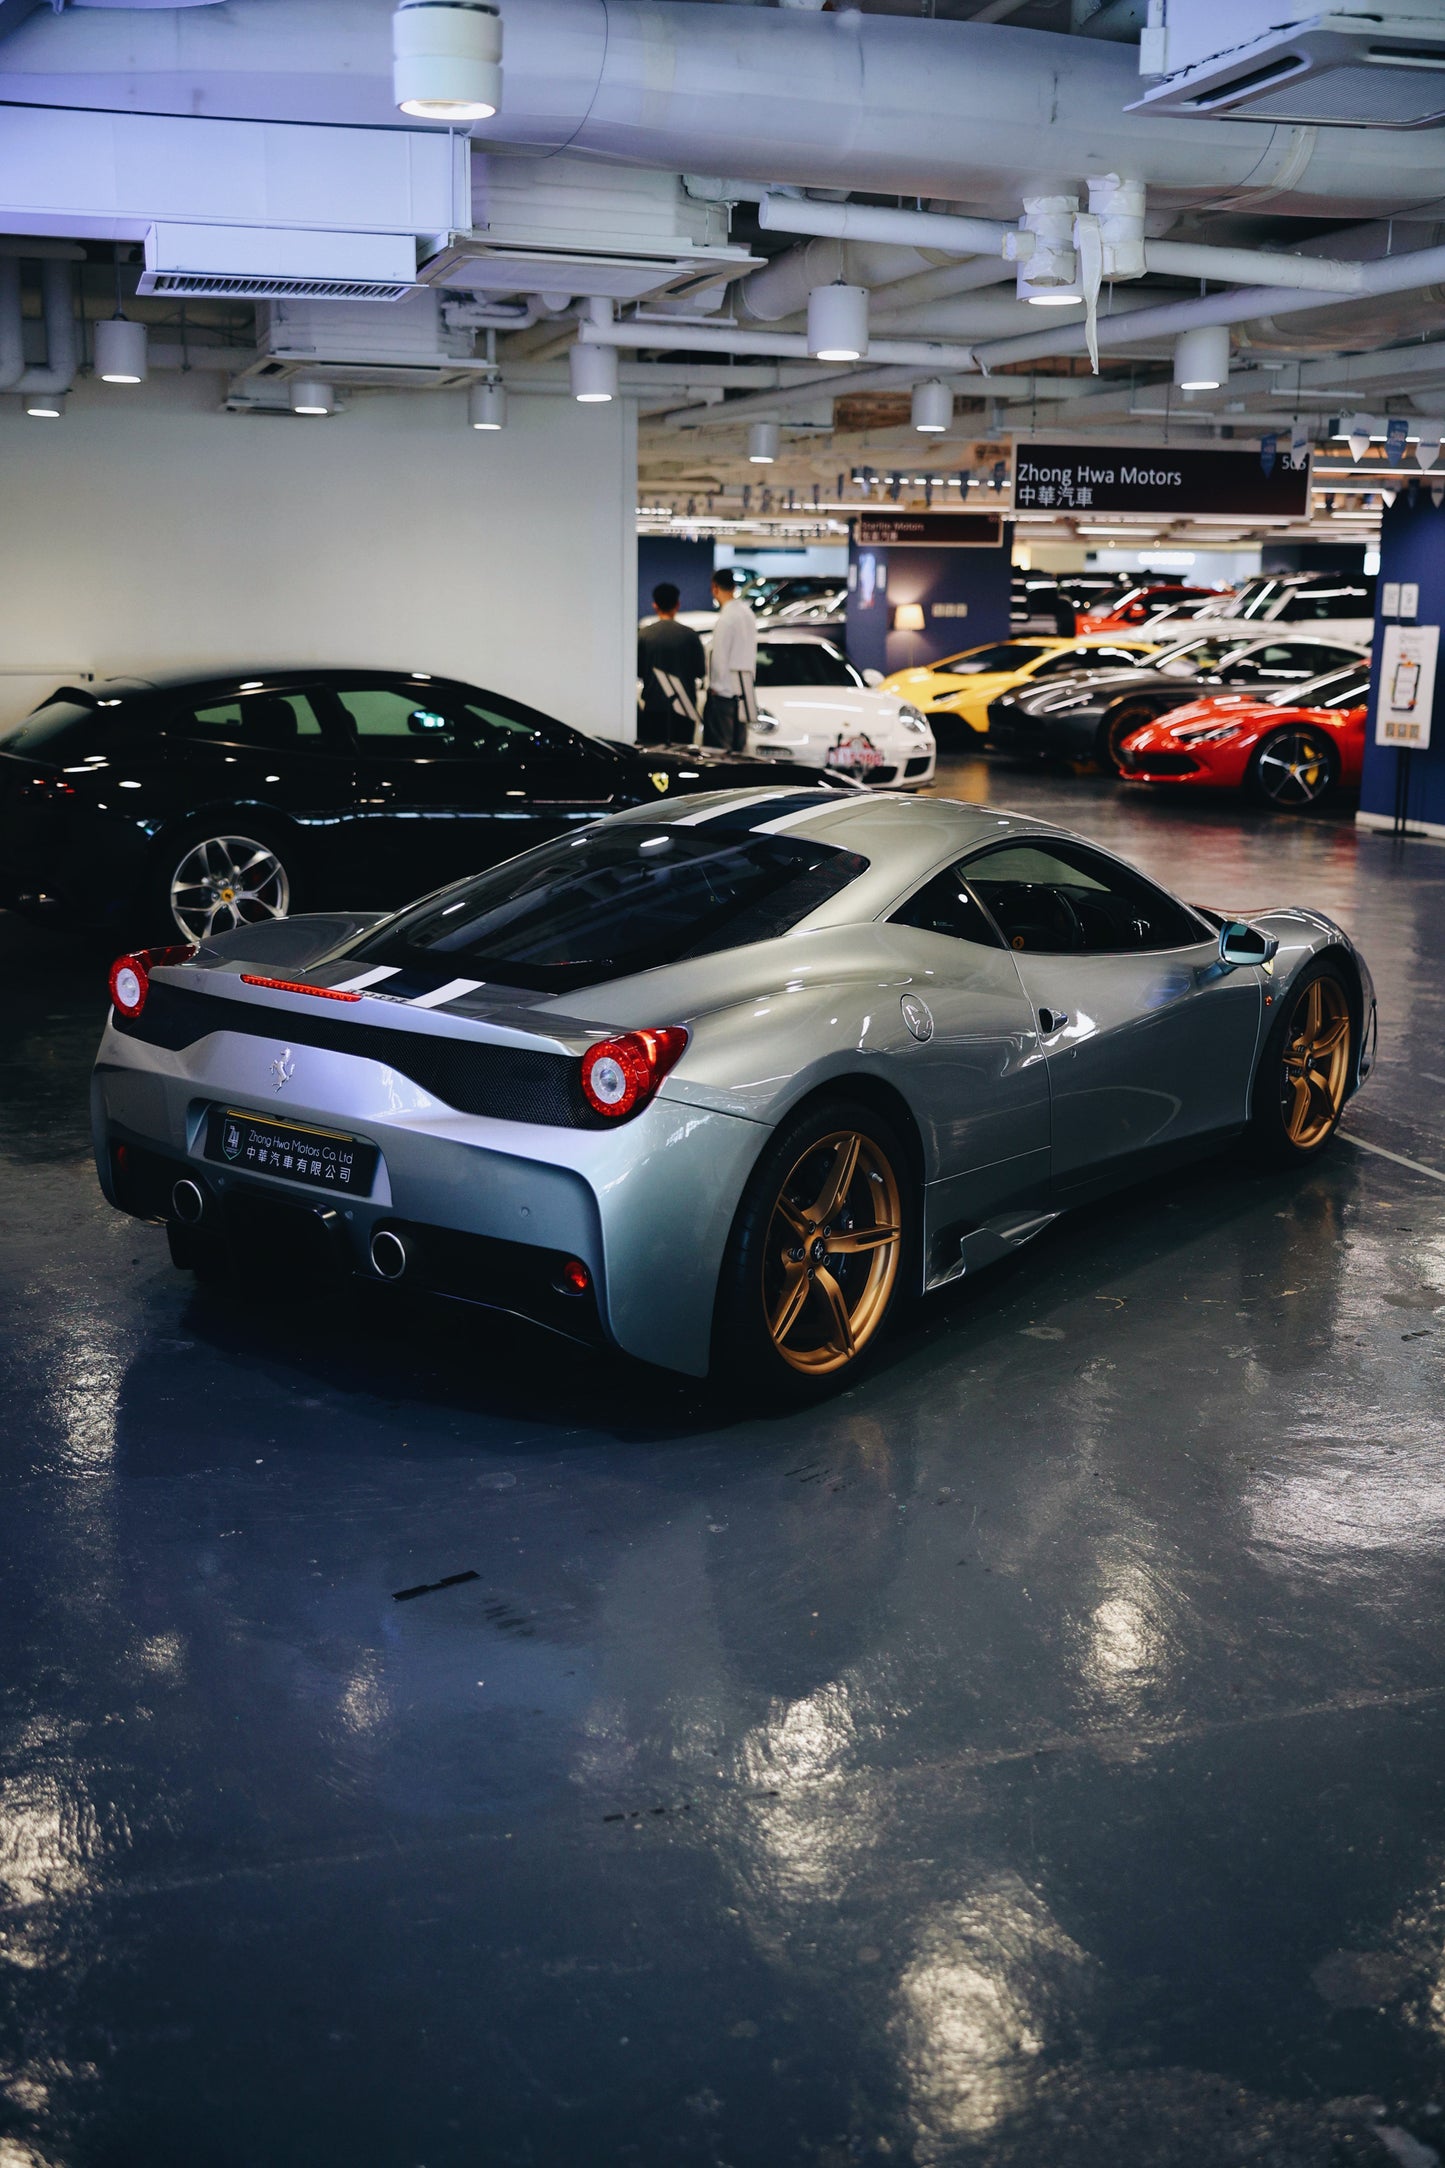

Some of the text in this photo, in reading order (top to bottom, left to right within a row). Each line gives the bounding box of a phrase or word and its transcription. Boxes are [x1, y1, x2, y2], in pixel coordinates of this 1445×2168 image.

[1018, 463, 1182, 487] Zhong Hwa Motors
[1019, 485, 1093, 508] 中華汽車
[248, 1129, 354, 1164] Zhong Hwa Motors Co. Ltd
[246, 1146, 351, 1183] 中華汽車有限公司
